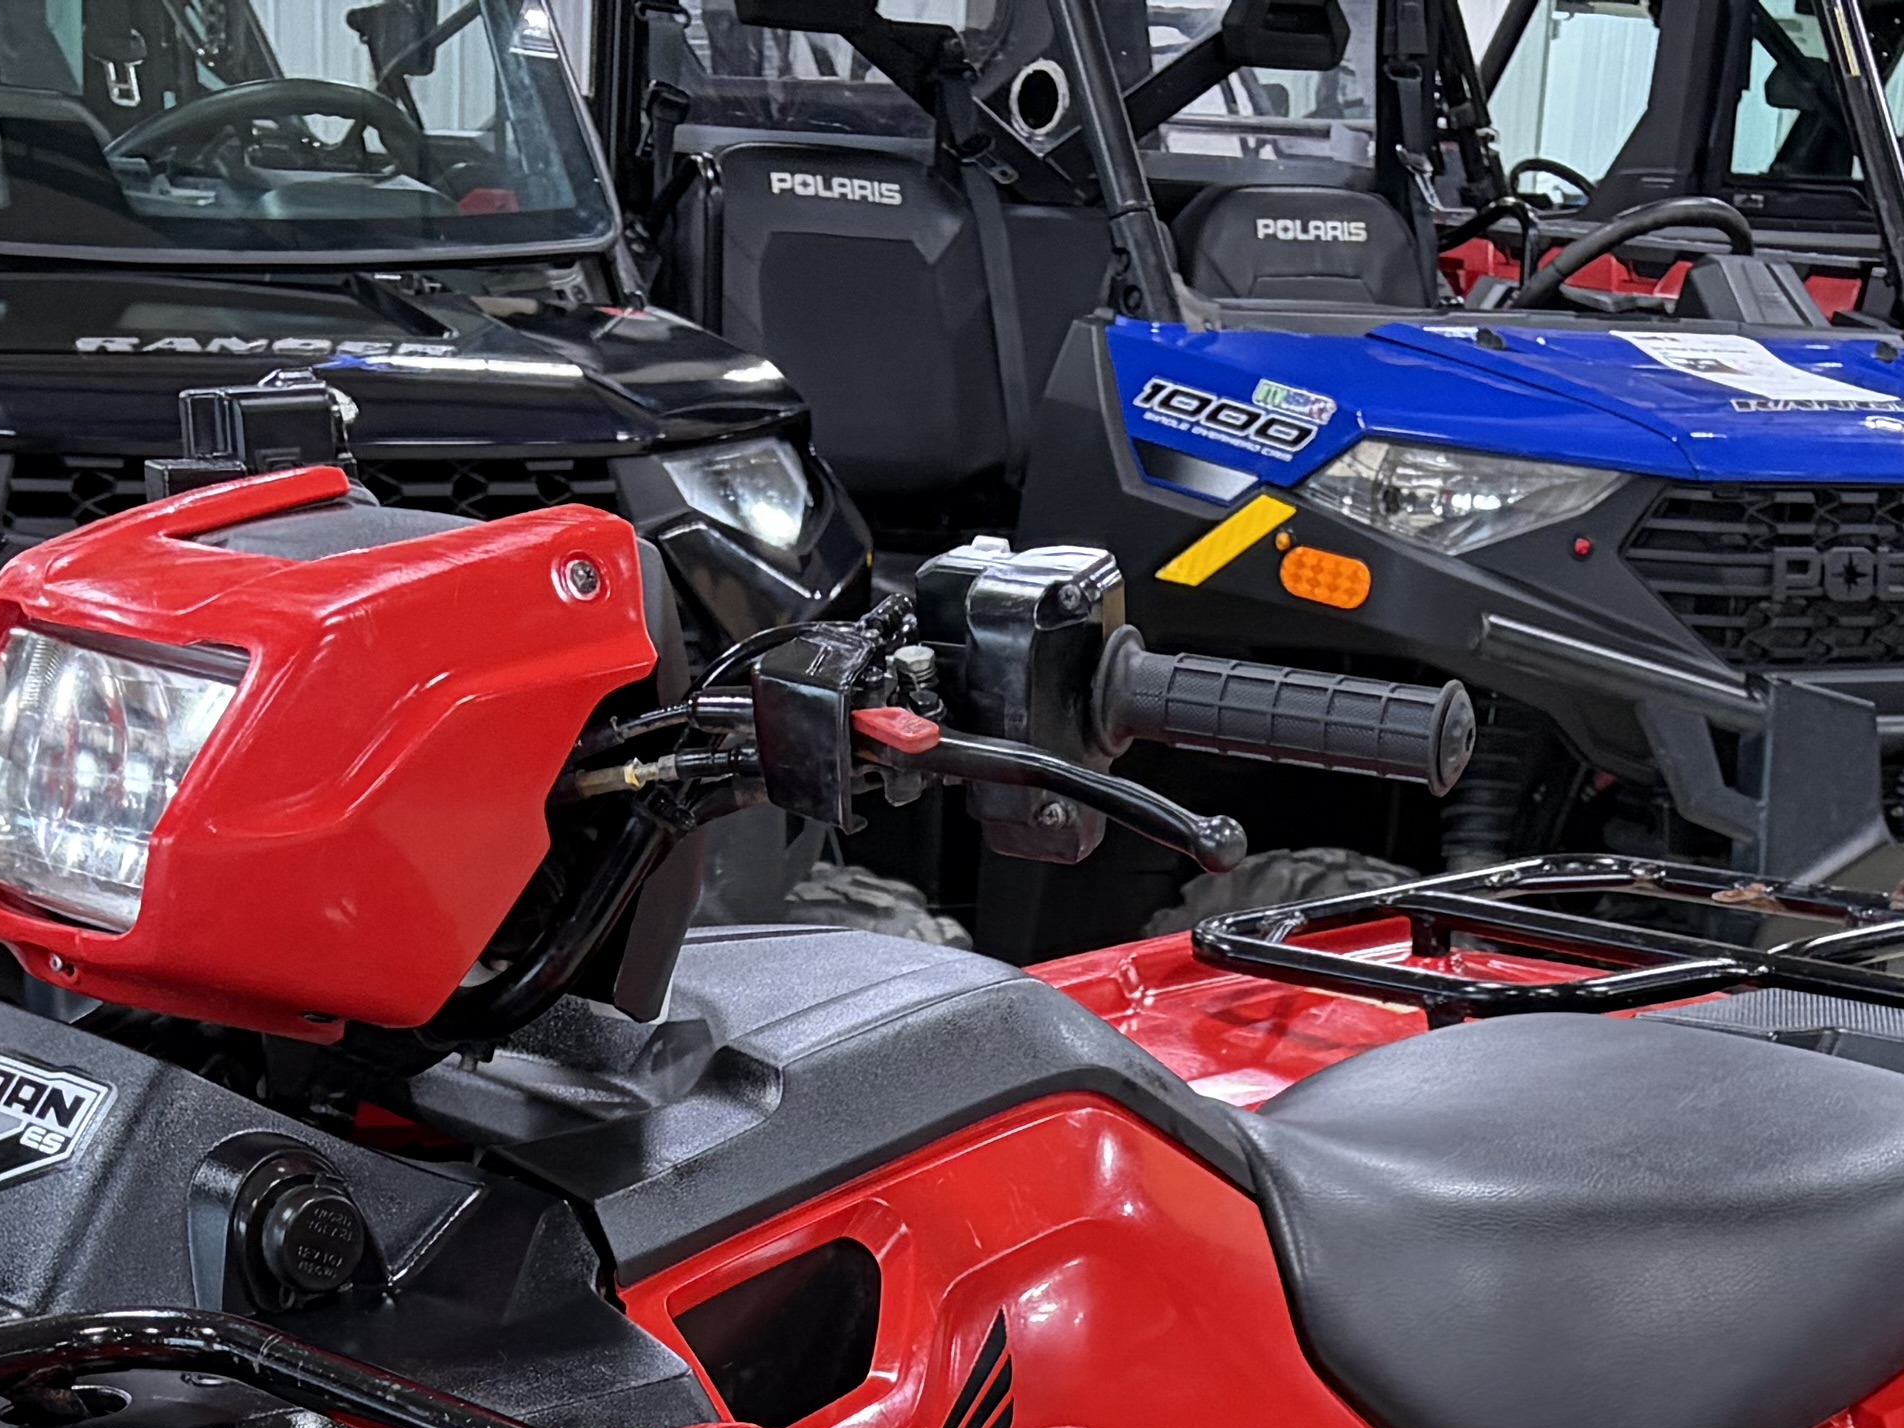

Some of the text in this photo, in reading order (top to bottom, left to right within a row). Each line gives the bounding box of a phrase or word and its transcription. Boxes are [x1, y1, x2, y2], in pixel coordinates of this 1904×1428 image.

[770, 172, 902, 205] POLARIS
[1256, 219, 1367, 241] POLARIS
[1132, 376, 1318, 453] 1000
[20, 1126, 65, 1154] ES
